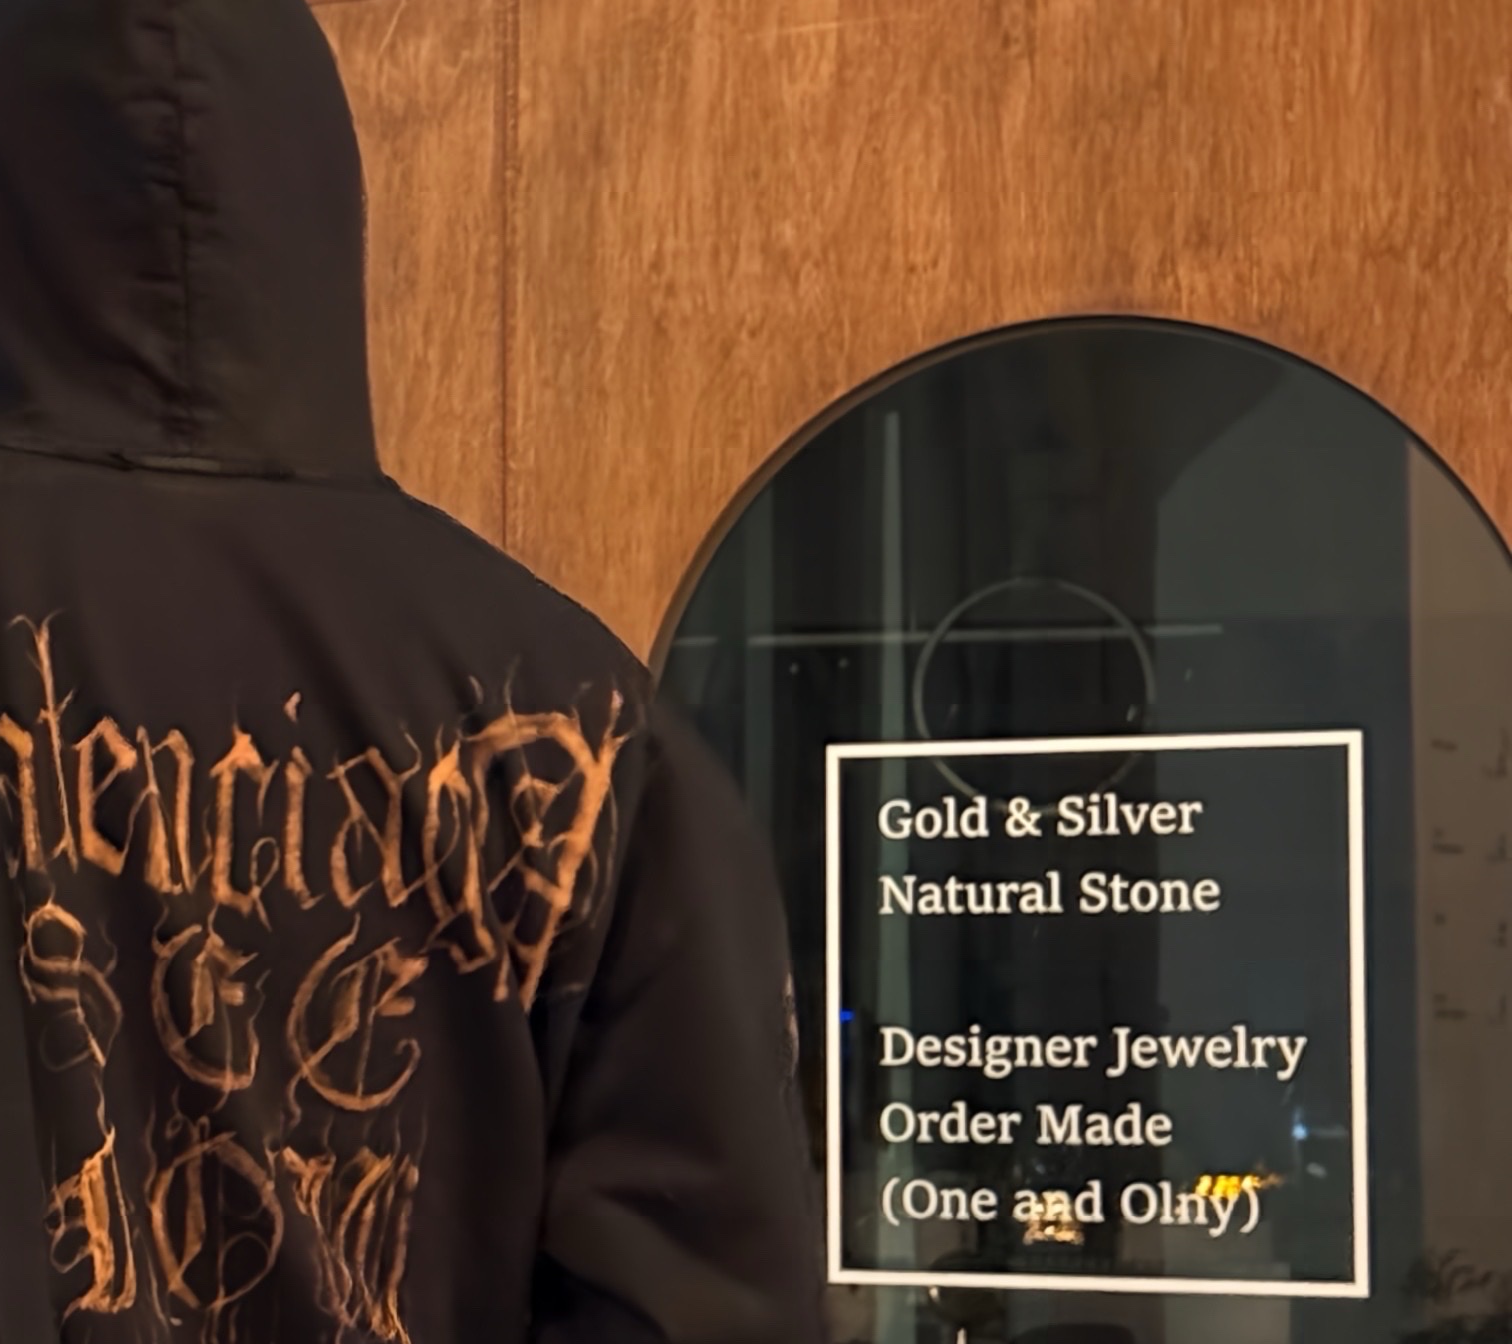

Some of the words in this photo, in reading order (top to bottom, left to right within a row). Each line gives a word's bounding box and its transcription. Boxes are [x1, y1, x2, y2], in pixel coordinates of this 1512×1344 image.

[878, 795, 990, 840] Gold
[1005, 797, 1042, 838] &
[1057, 792, 1204, 837] Silver
[878, 870, 1064, 915] Natural
[1079, 871, 1221, 914] Stone
[880, 1024, 1098, 1079] Designer
[1106, 1024, 1308, 1081] Jewelry
[880, 1100, 1022, 1144] Order
[1036, 1102, 1173, 1146] Made
[882, 1176, 998, 1227] (One
[1013, 1179, 1105, 1224] and
[1120, 1177, 1261, 1238] Olny)
